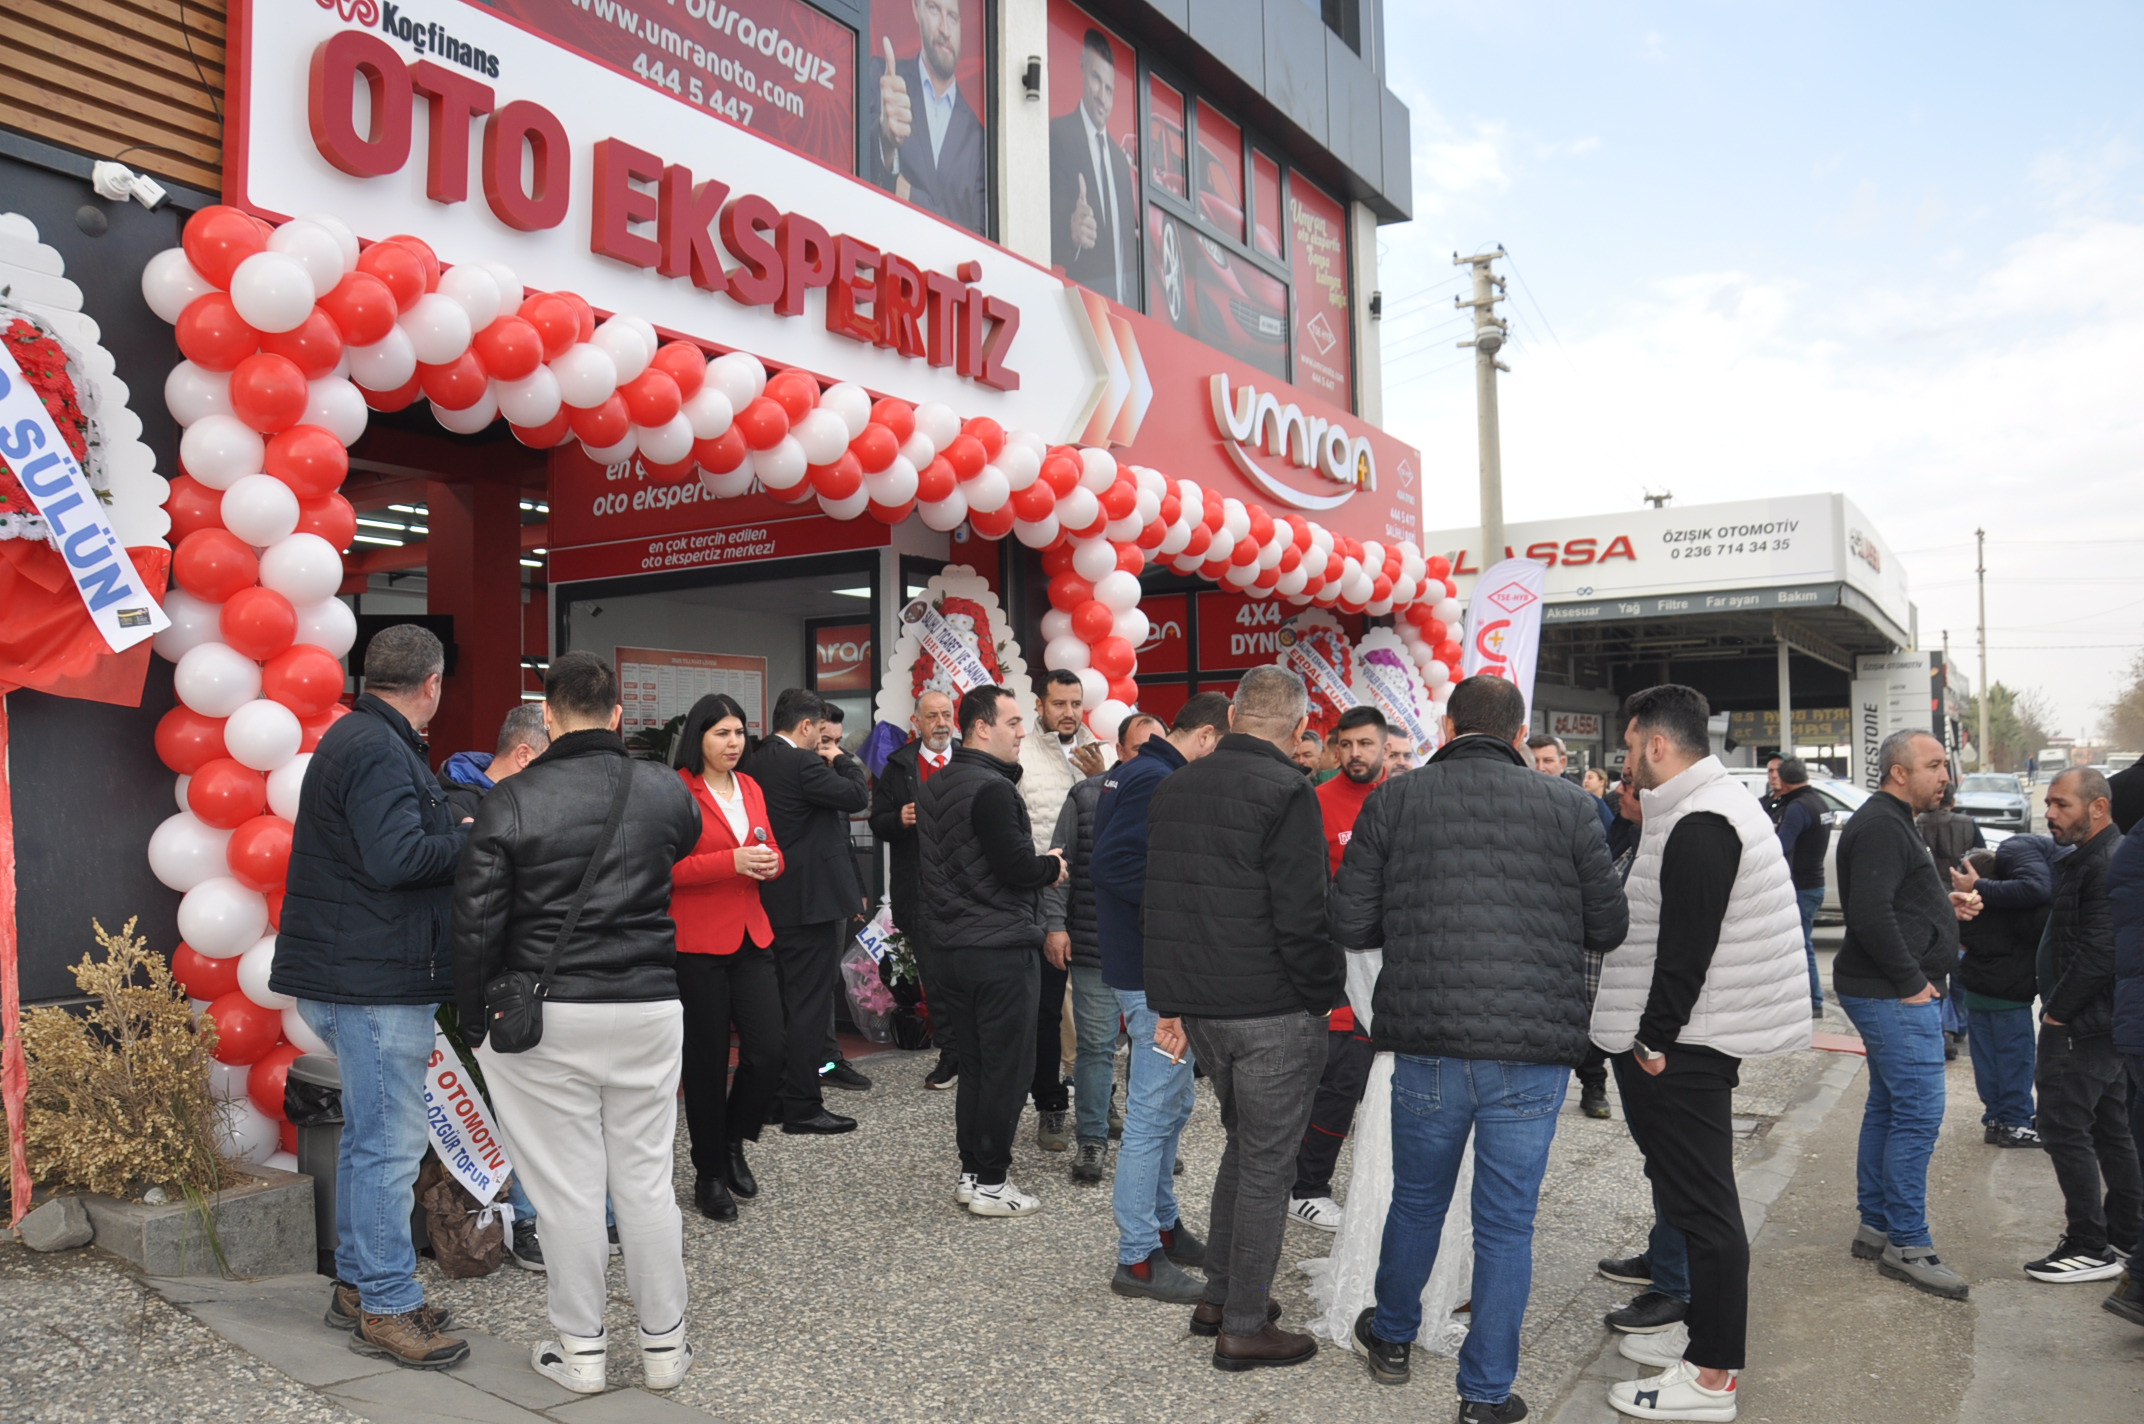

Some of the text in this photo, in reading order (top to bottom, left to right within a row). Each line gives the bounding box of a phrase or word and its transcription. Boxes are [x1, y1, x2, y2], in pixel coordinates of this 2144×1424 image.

[382, 1, 500, 79] Koçfinans
[632, 52, 754, 126] 444 5 447
[308, 30, 1020, 391] OTO EKSPERTİZ
[1210, 372, 1377, 493] umran
[1, 418, 133, 613] SÜLÜN
[593, 491, 628, 516] oto
[649, 528, 767, 554] en çok tercih edilen
[1663, 518, 1799, 544] ÖZIŞIK OTOMOTİV
[641, 541, 776, 569] oto ekspertiz merkezi
[1453, 535, 1637, 576] LSSA
[1671, 538, 1790, 559] 0 236 714 34 35
[1546, 606, 1601, 619] Aksesuar
[1618, 602, 1641, 616] Yağ
[1658, 599, 1689, 611] Filtre
[1706, 595, 1760, 608] Far ayarı
[1778, 591, 1818, 603] Bakım
[1236, 602, 1281, 627] 4X4
[922, 634, 961, 677] İBRAHİM
[939, 627, 963, 655] TİCARET
[955, 649, 971, 666] VE
[1289, 648, 1322, 683] ERDAL
[437, 1070, 506, 1171] OTOMOTİV
[428, 1103, 491, 1191] ÖZGÜR TOFUR
